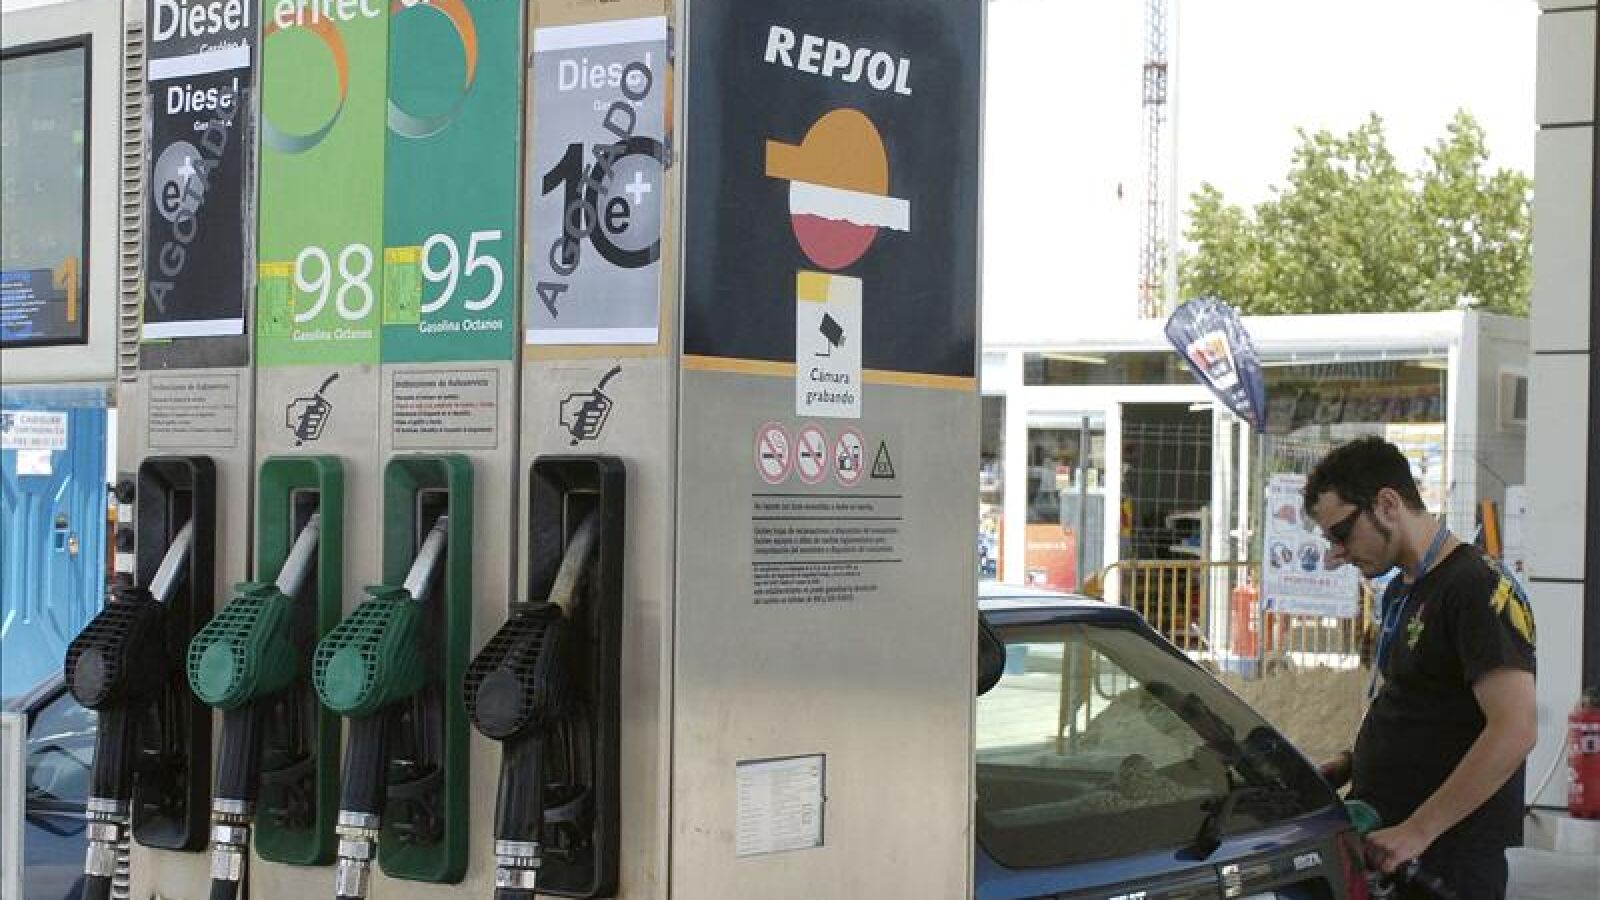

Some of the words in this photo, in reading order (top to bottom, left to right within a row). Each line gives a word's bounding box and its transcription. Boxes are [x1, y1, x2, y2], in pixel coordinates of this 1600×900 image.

[153, 0, 249, 41] Diesel
[764, 26, 912, 95] REPSOL
[536, 62, 652, 319] AGOTADO
[53, 254, 77, 322] 1
[295, 243, 373, 323] 98
[420, 230, 503, 313] 95
[419, 321, 461, 334] Gasolina
[463, 319, 503, 332] Octanos
